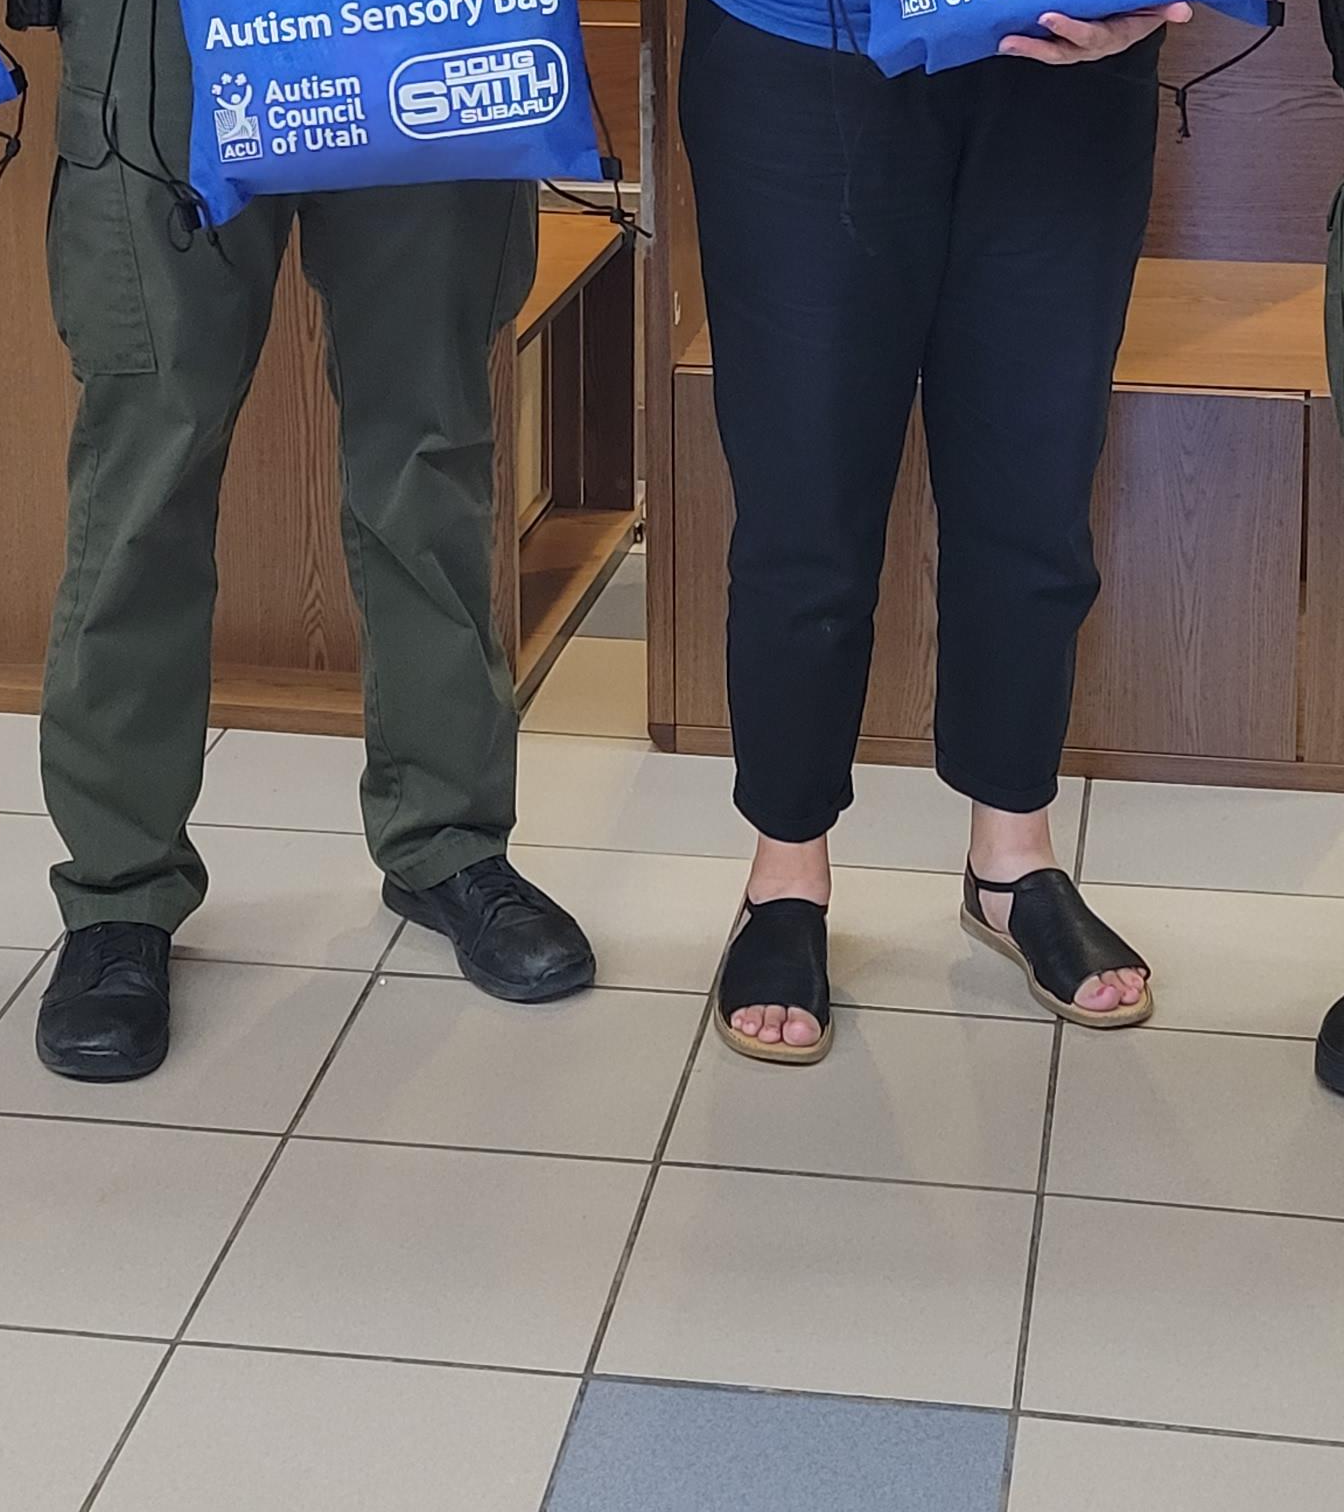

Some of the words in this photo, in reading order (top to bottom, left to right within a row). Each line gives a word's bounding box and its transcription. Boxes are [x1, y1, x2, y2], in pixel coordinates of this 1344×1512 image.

[205, 10, 333, 51] Autism
[443, 49, 535, 76] DOUG
[264, 73, 362, 105] Autism
[398, 62, 558, 126] SMITH
[268, 97, 365, 129] Council
[459, 96, 554, 125] SUBARU
[223, 140, 259, 159] ACU
[271, 127, 300, 155] of
[305, 124, 369, 151] Utah
